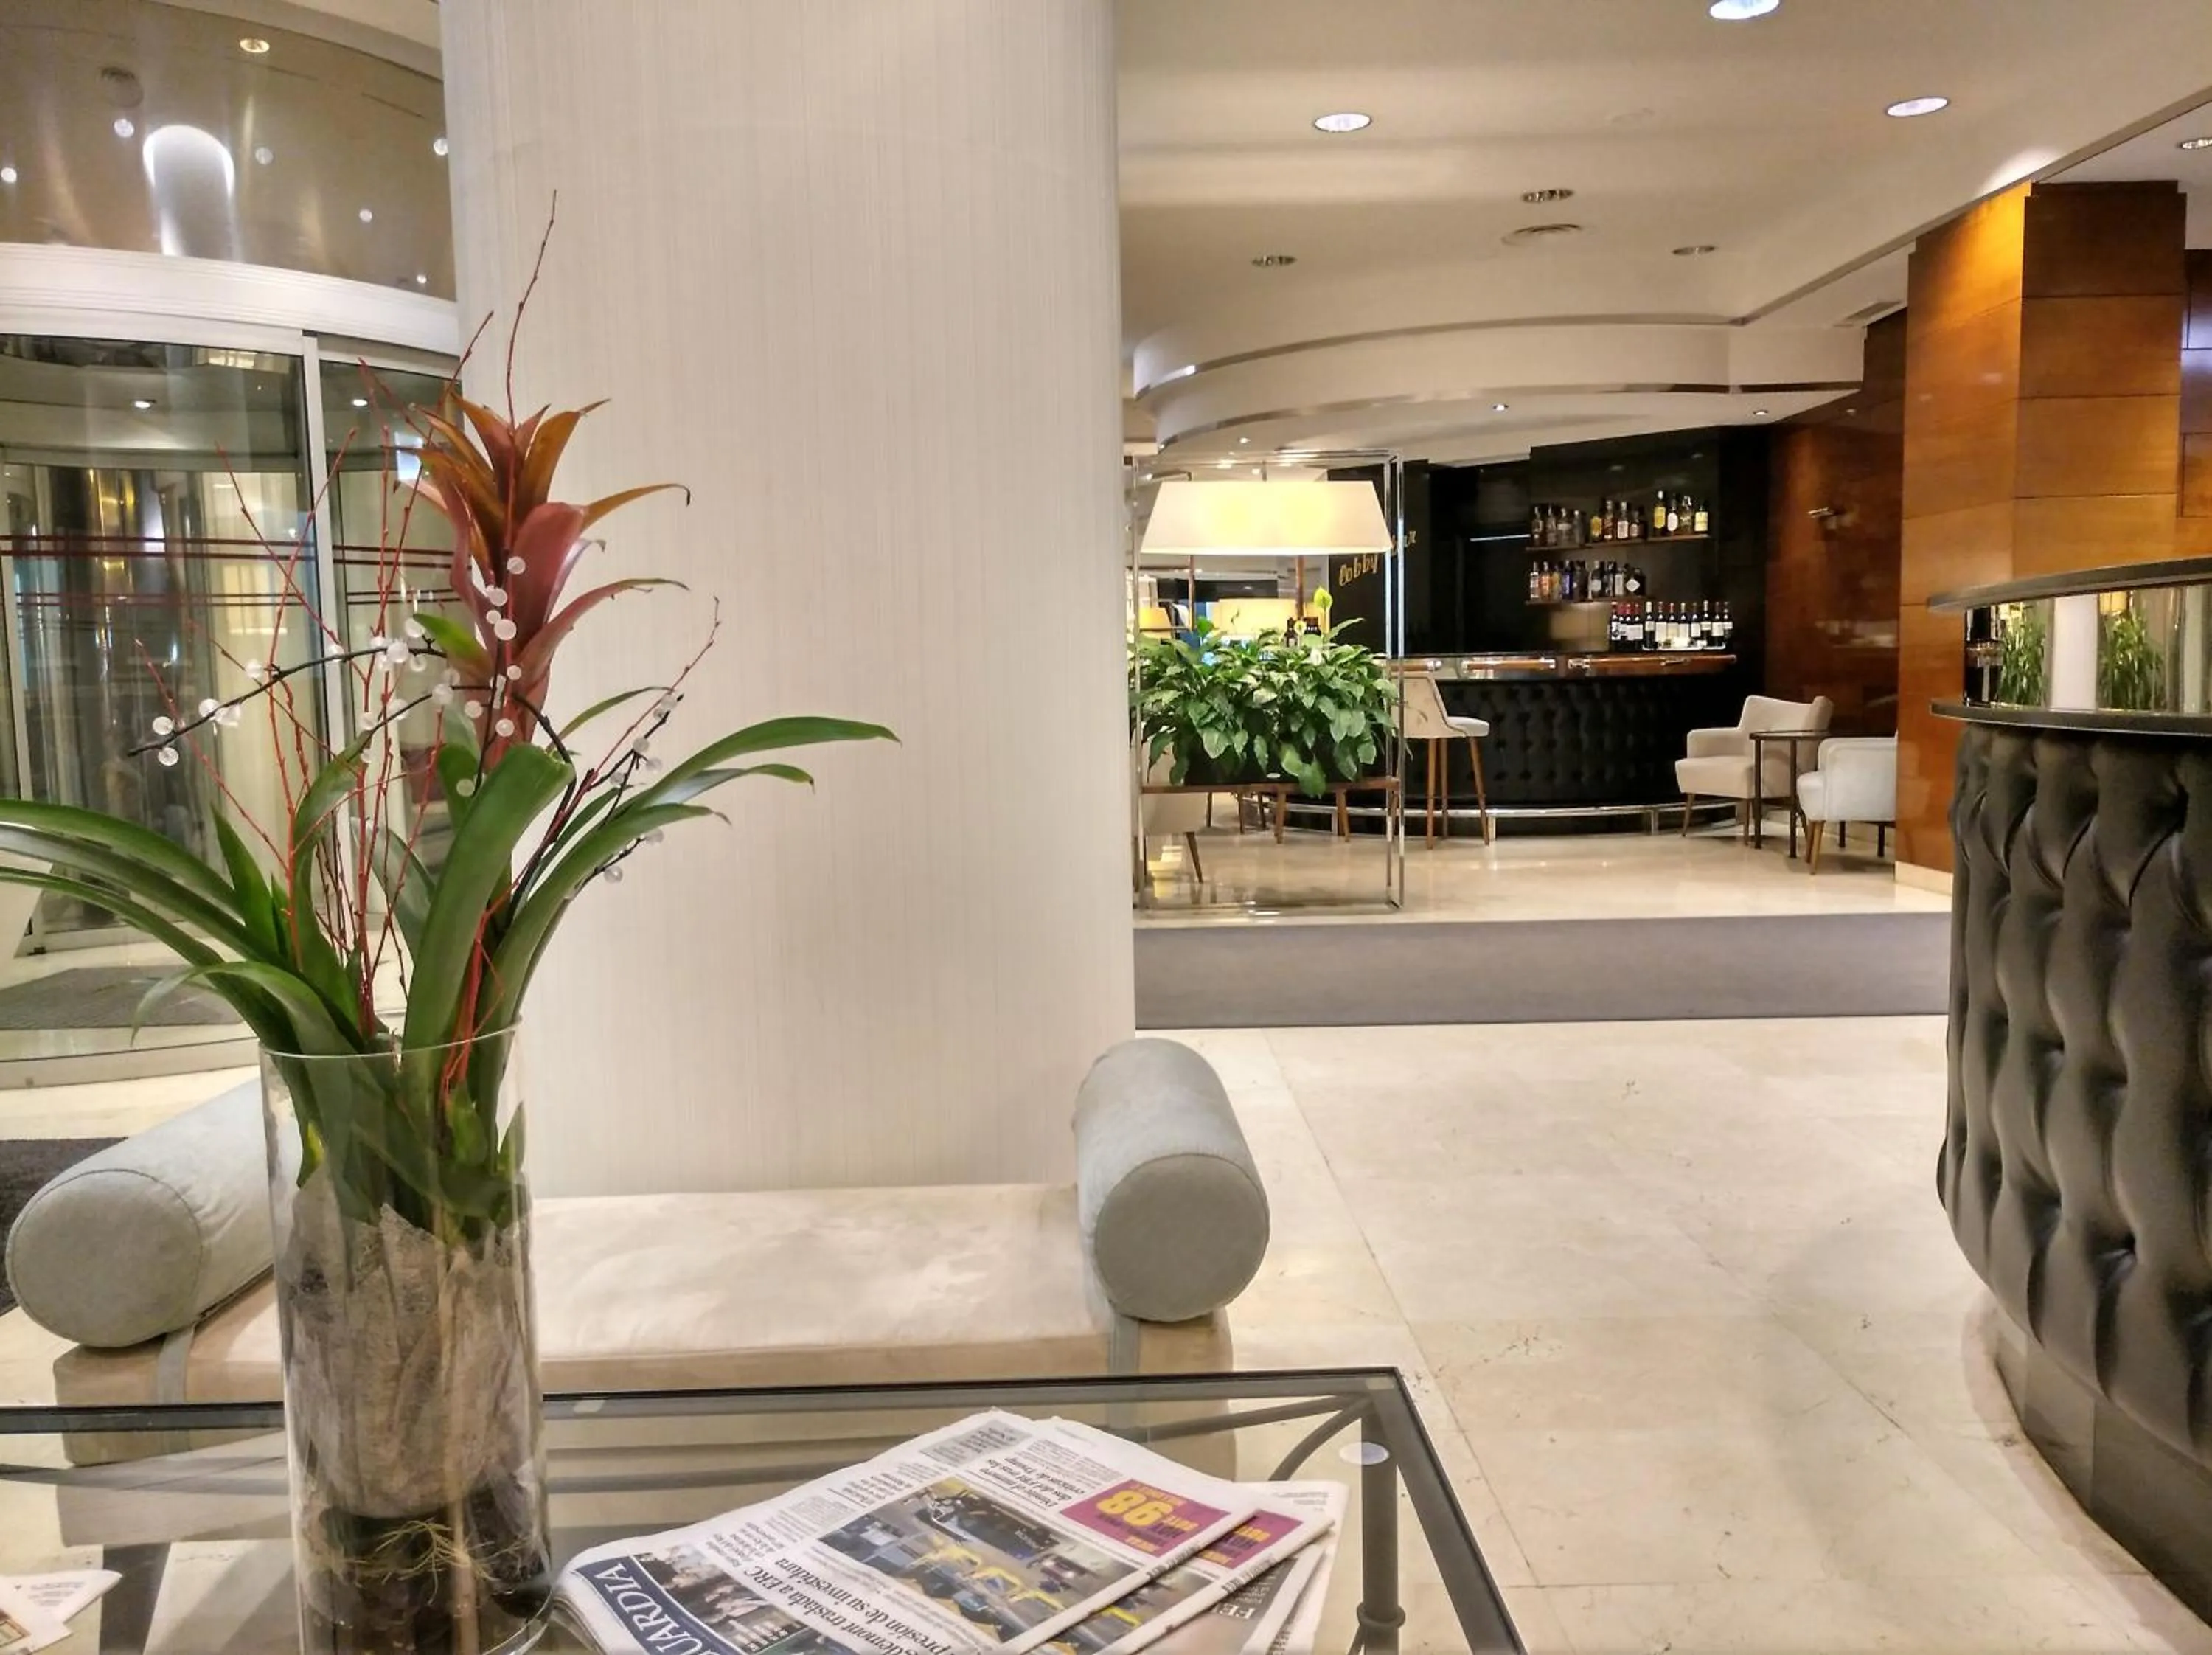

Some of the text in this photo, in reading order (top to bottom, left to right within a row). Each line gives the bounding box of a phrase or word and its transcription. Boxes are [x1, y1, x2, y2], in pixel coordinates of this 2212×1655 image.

[1338, 553, 1378, 587] lobby
[1097, 1490, 1174, 1527] 98
[743, 1565, 784, 1590] ERC
[774, 1558, 852, 1605] investidura
[778, 1583, 794, 1595] a
[594, 1563, 721, 1655] UARDIA
[788, 1592, 847, 1627] traslada
[846, 1597, 870, 1612] su
[865, 1608, 889, 1625] de
[885, 1619, 952, 1655] presión
